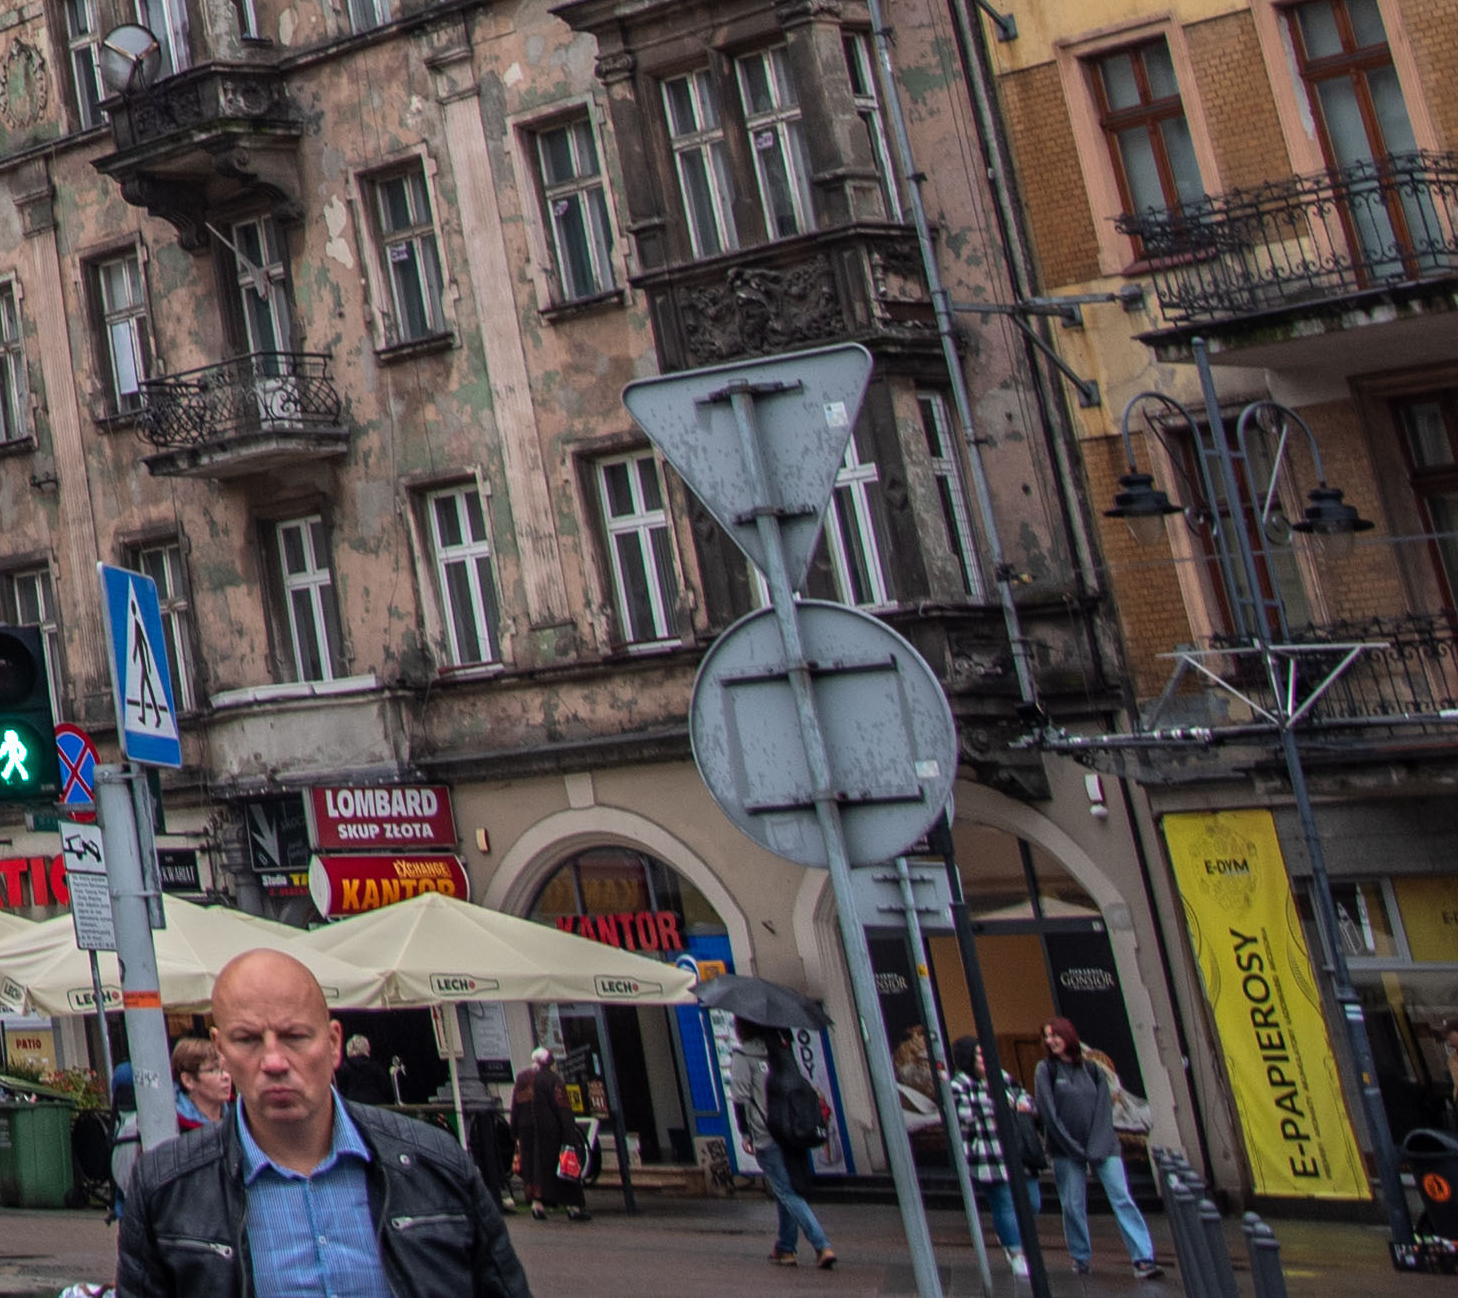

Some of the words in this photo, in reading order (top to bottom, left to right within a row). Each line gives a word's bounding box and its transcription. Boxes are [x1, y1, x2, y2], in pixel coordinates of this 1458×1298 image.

[325, 789, 438, 818] LOMBARD
[338, 825, 379, 840] SKUP
[383, 822, 434, 839] ZŁOTA
[1204, 859, 1250, 875] E-DYM
[437, 979, 468, 991] LECH
[16, 1038, 42, 1050] PATIO
[1229, 927, 1320, 1179] E-PAPIEROSY
[798, 1029, 815, 1079] ODY
